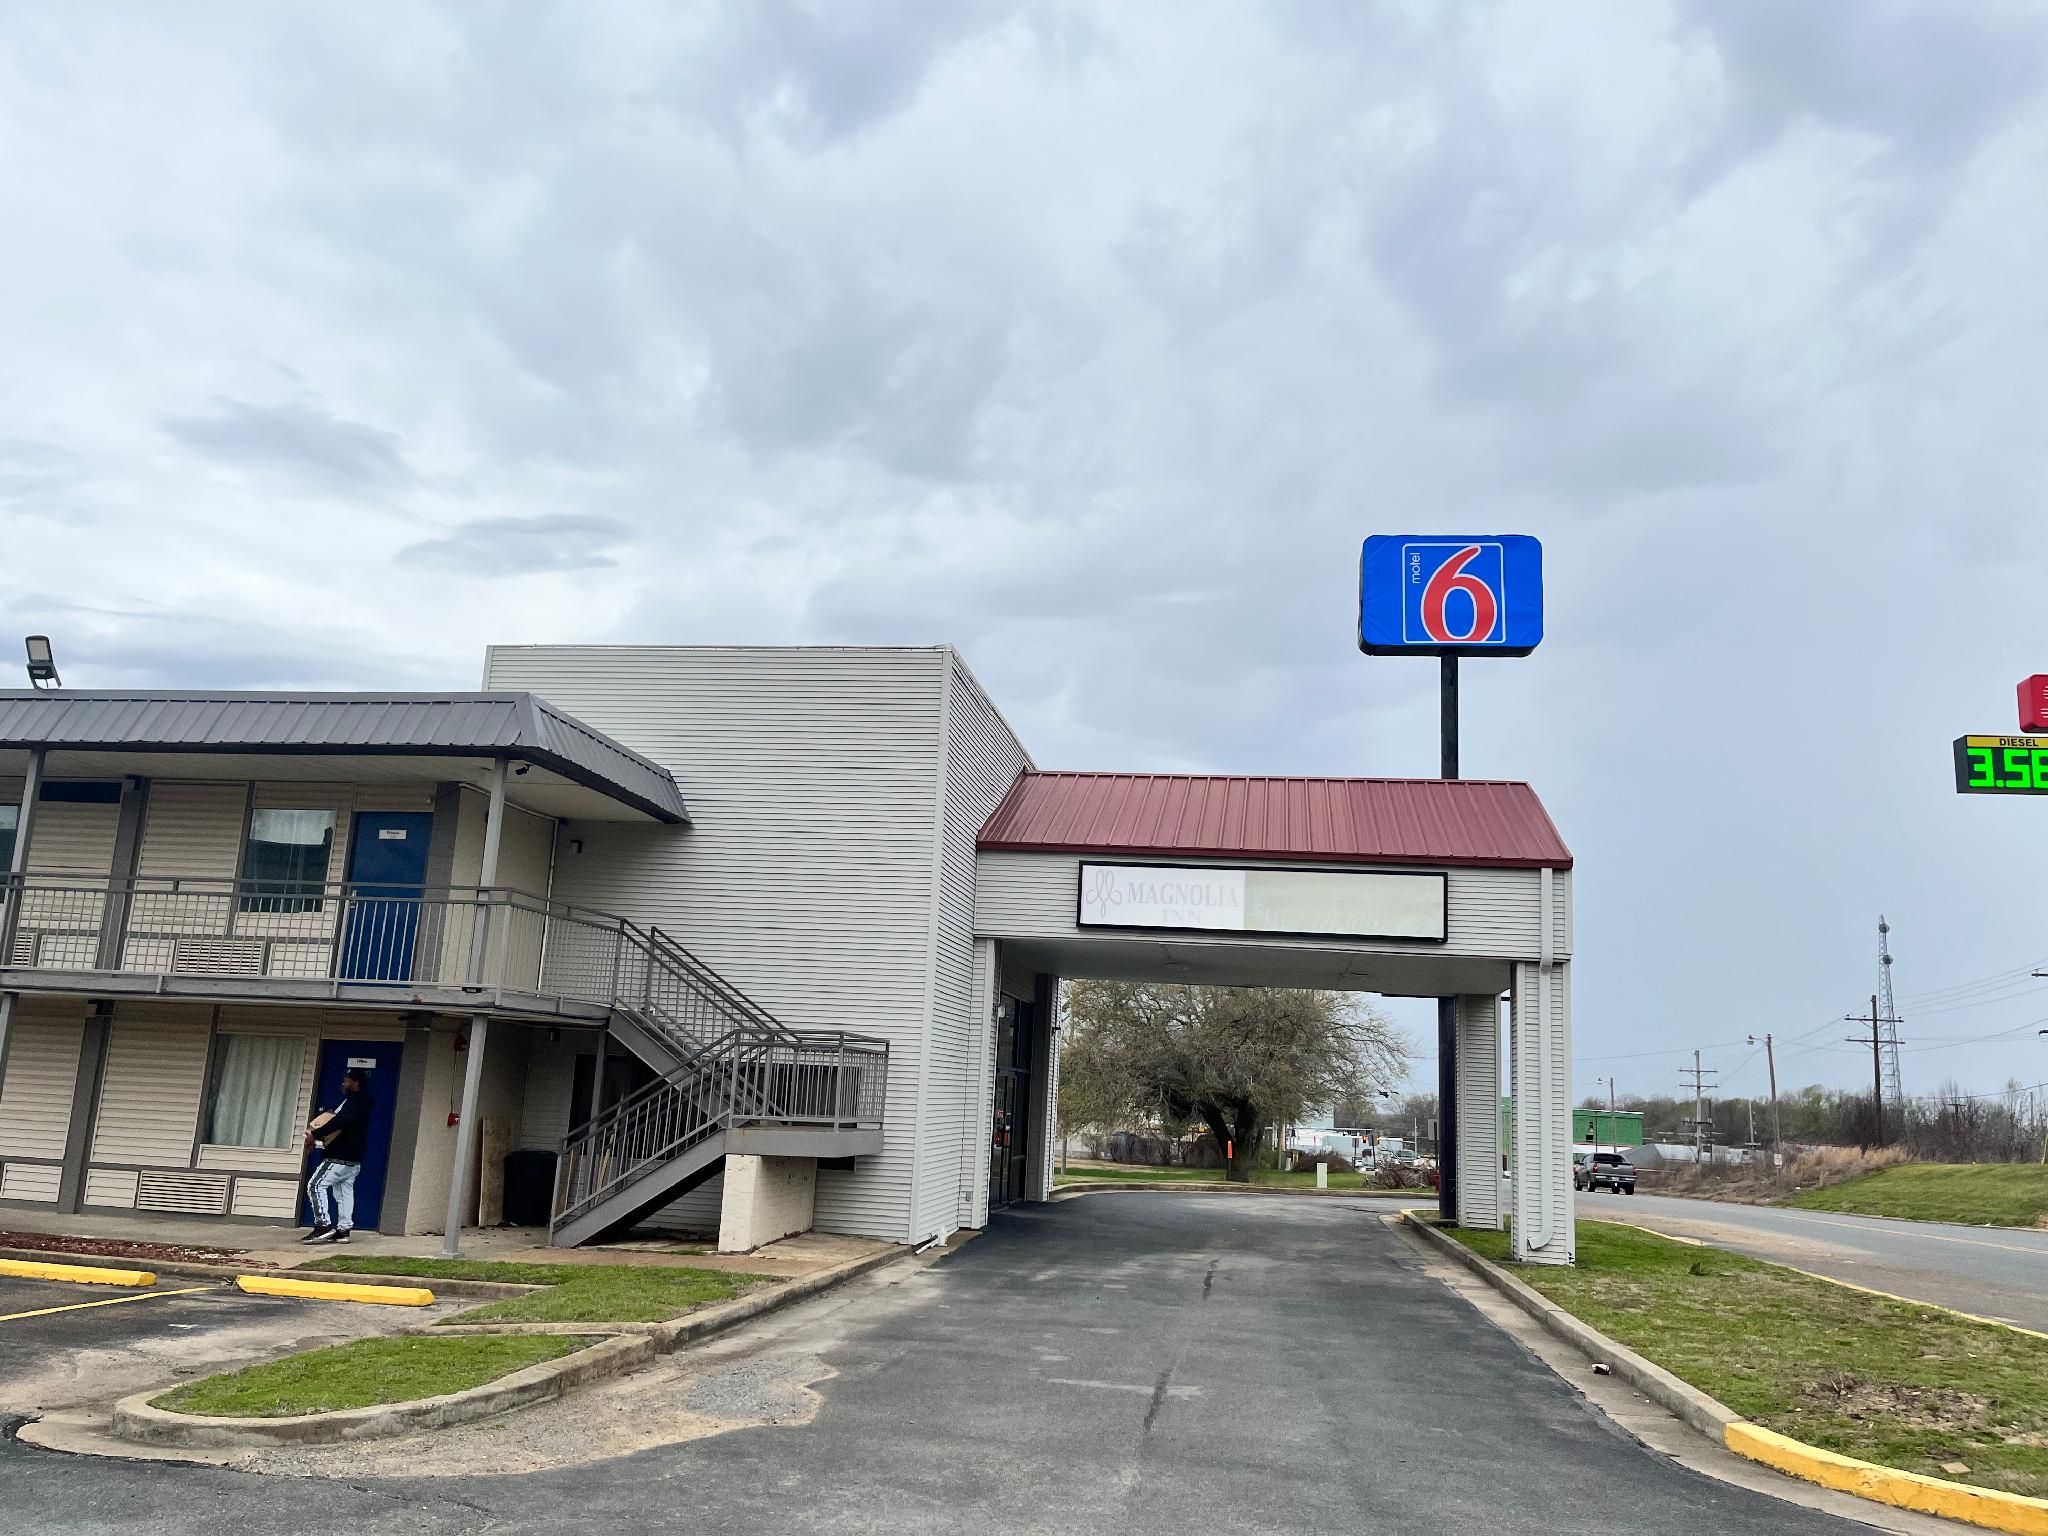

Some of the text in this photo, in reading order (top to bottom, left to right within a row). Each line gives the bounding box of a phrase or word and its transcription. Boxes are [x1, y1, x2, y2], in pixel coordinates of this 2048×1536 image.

[1410, 552, 1421, 584] motel
[1421, 545, 1498, 642] 6
[1999, 738, 2039, 747] DIESEL
[1127, 881, 1240, 907] MAGNOLIA
[1160, 908, 1203, 924] INN
